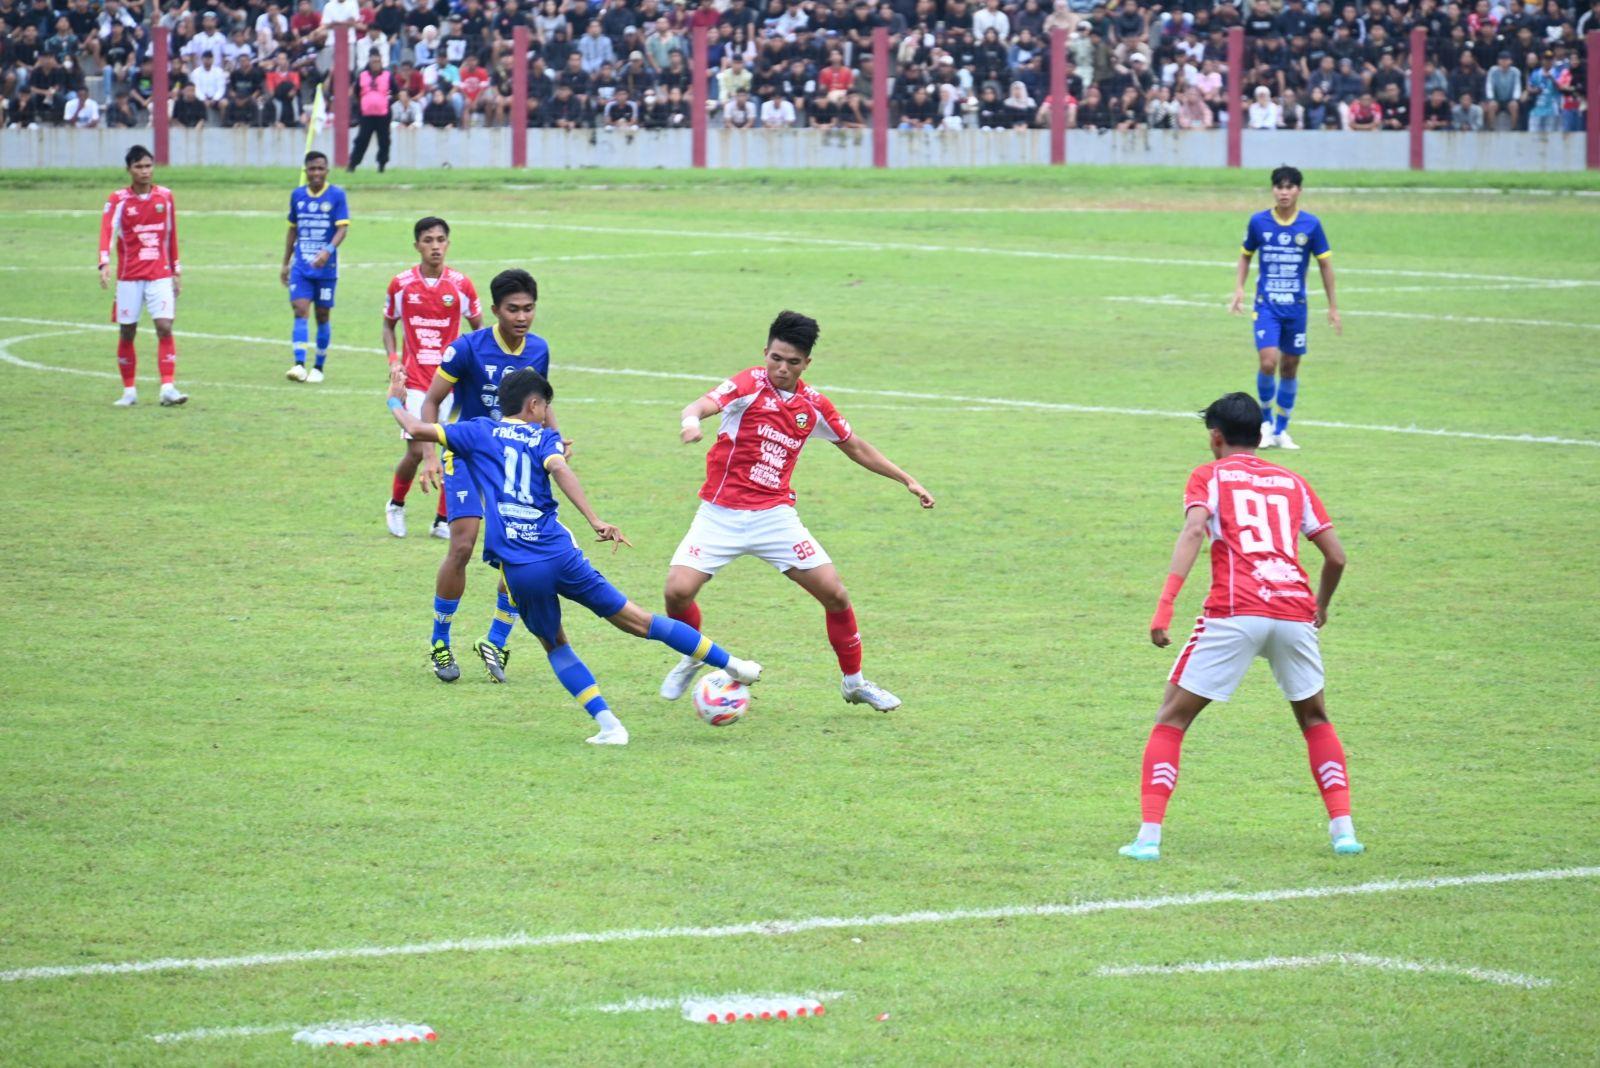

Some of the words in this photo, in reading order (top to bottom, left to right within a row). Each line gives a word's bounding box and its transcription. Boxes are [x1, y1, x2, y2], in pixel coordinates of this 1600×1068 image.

[757, 424, 802, 450] Vitameal
[503, 445, 534, 505] 11
[1232, 489, 1296, 559] 91
[792, 539, 815, 561] 33
